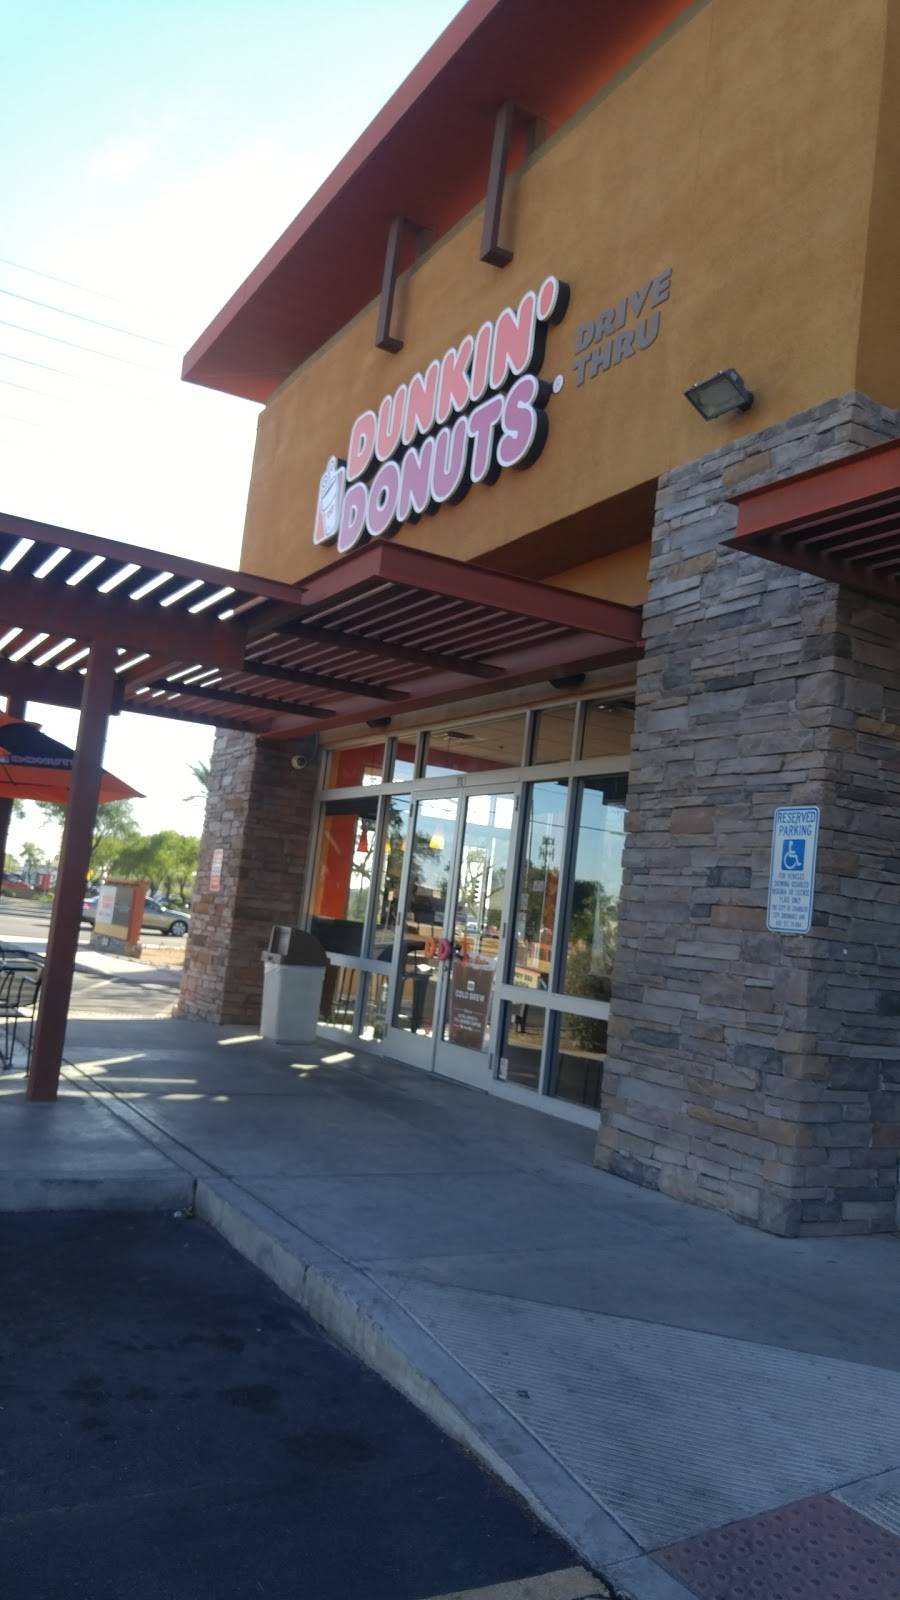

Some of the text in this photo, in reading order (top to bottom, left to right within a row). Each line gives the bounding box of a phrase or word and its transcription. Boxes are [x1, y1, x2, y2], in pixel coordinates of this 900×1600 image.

[572, 311, 661, 388] THRU
[575, 267, 673, 355] DRIVE
[346, 275, 560, 482] DUNKIN'
[337, 374, 541, 553] DONUTS
[778, 812, 816, 824] RESERVED
[778, 824, 813, 836] PARKING
[455, 989, 485, 1002] COLD BREW
